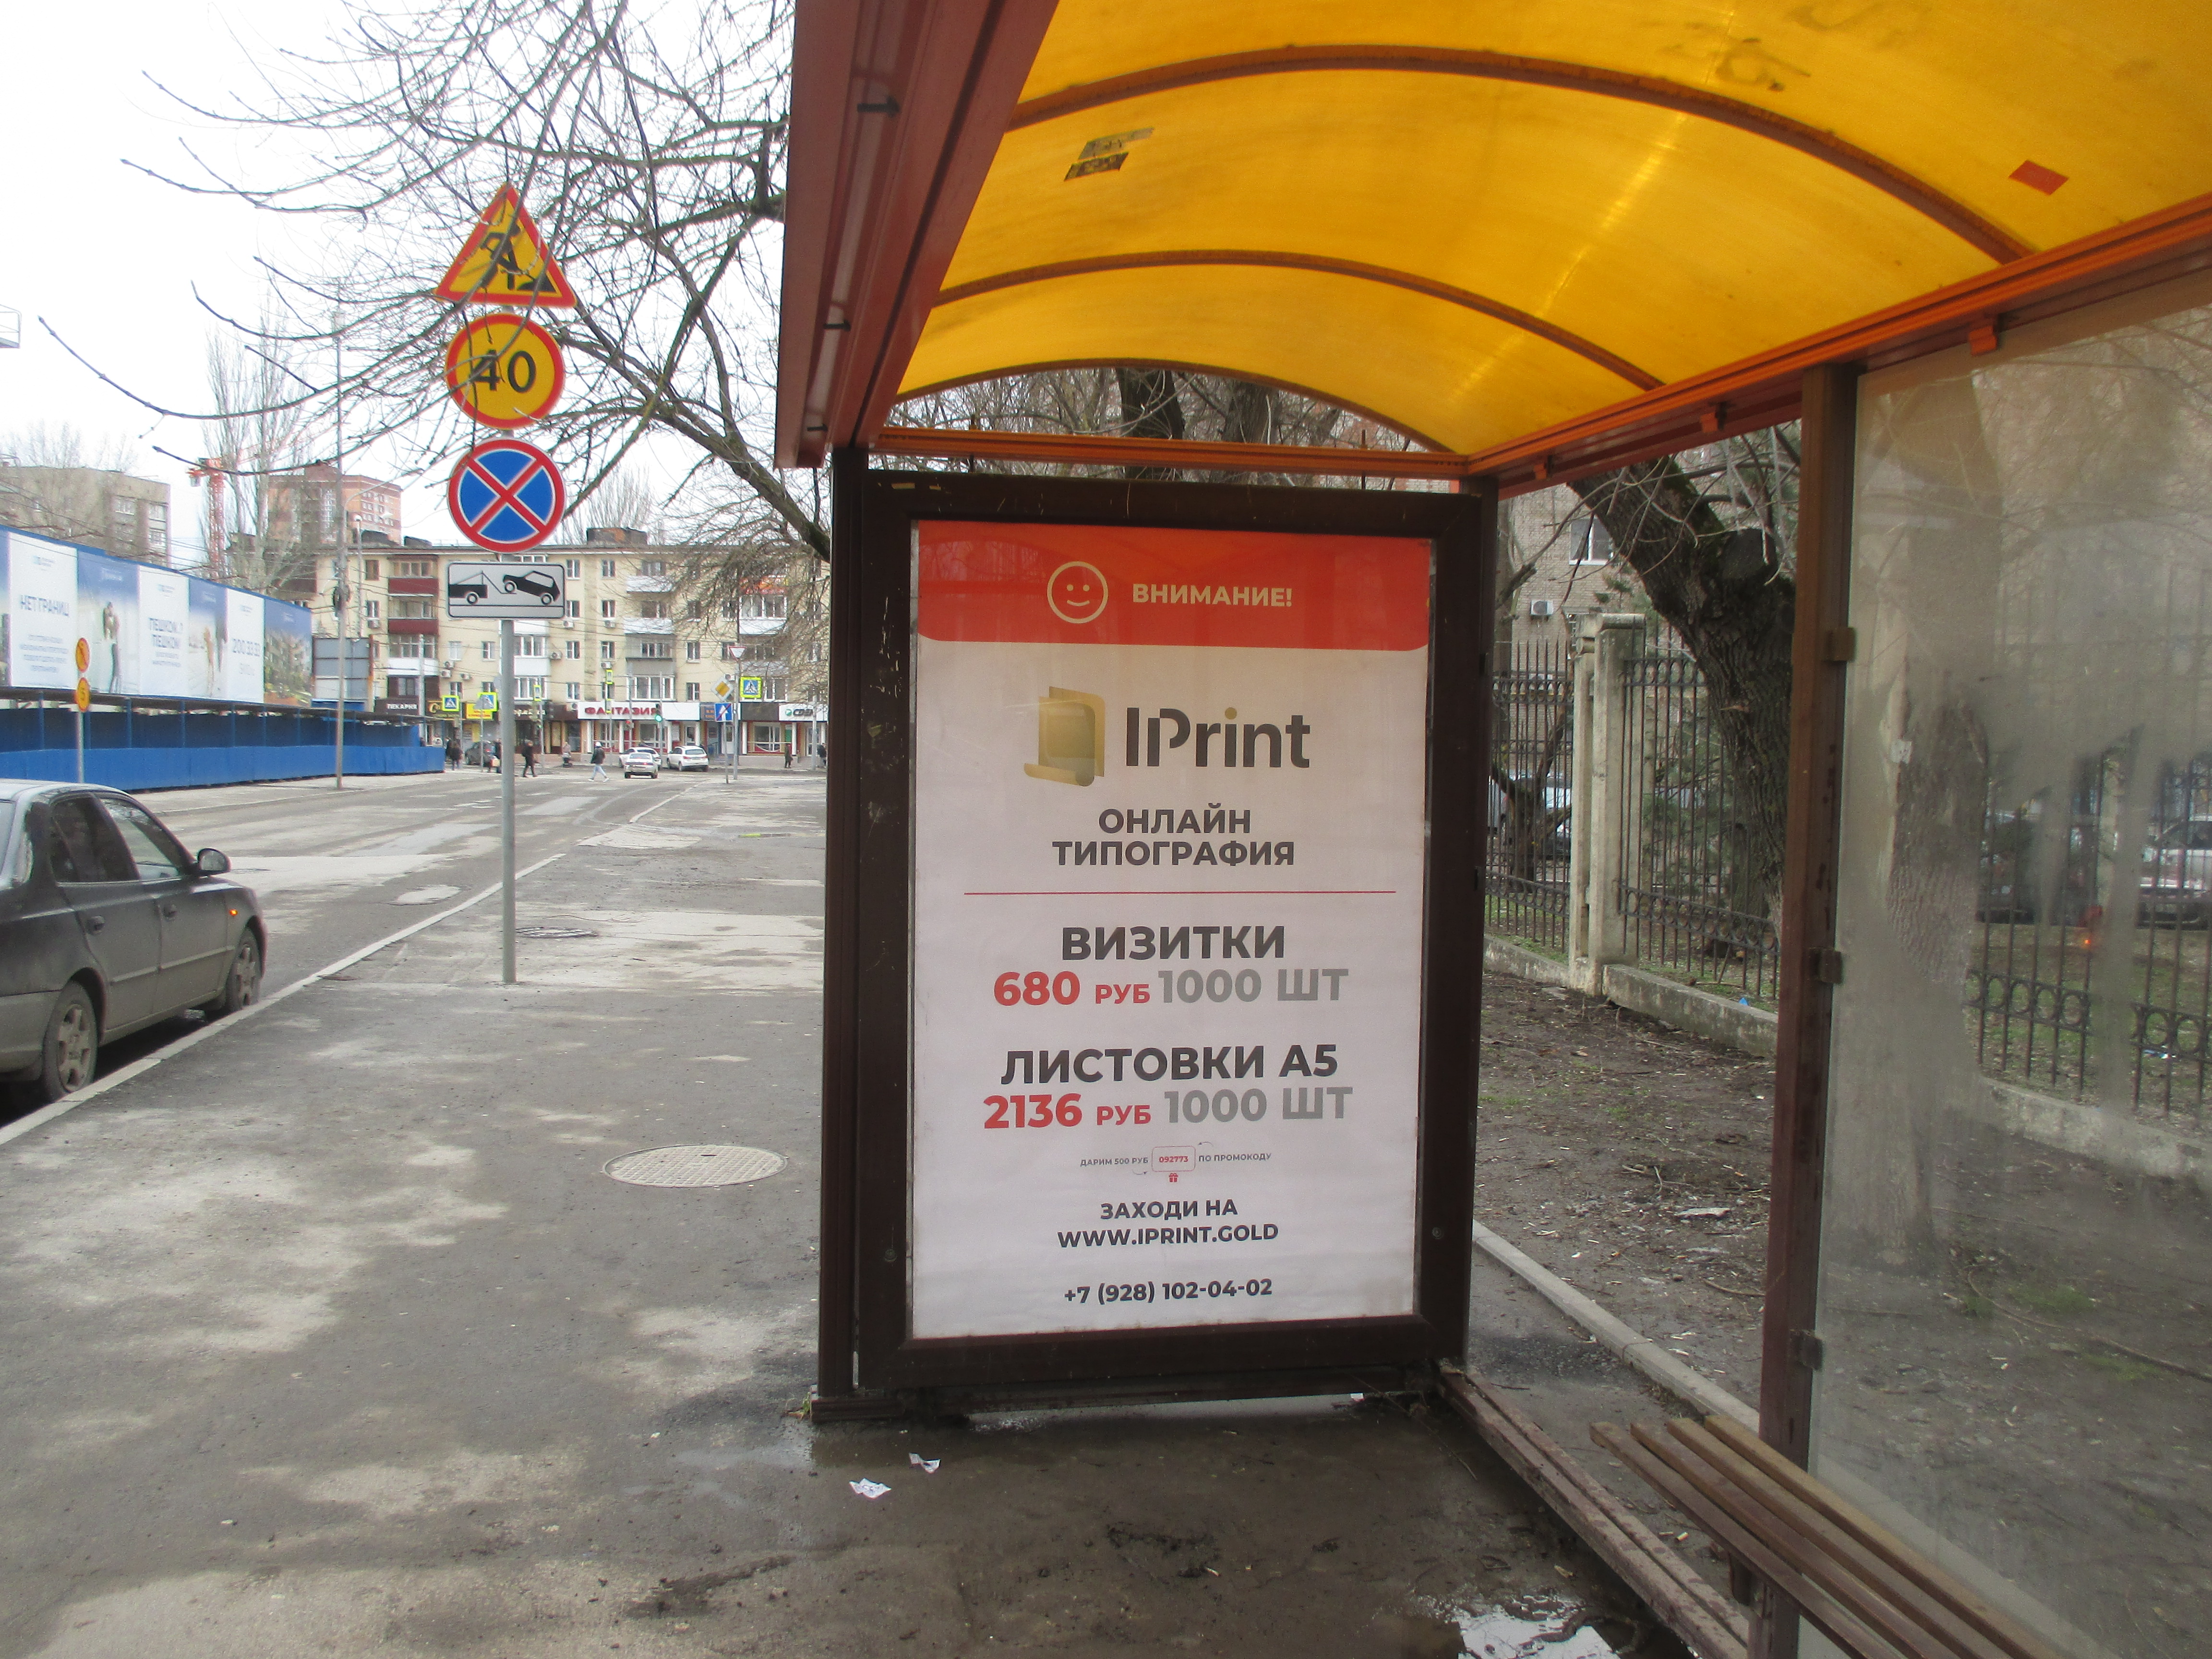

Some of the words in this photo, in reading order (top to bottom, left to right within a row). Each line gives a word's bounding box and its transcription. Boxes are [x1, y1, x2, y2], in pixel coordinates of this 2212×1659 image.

[469, 349, 536, 393] 40
[1134, 584, 1292, 607] ВНИМАНИЕ!
[1127, 707, 1310, 769] IPrint
[1099, 803, 1250, 834] ОНЛАЙН
[1053, 841, 1294, 866] ТИПОГРАФИЯ
[1063, 926, 1285, 961] ВИЗИТКИ
[995, 972, 1080, 1006] 680
[1096, 985, 1150, 1004] РУБ
[1159, 969, 1262, 1003] 1000
[1278, 969, 1349, 1001] ШТ
[1002, 1046, 1264, 1085] ЛИСТОВКИ
[1280, 1045, 1337, 1077] А5
[984, 1094, 1082, 1129] 2136
[1097, 1106, 1151, 1126] РУБ
[1165, 1089, 1267, 1123] 1000
[1283, 1087, 1353, 1120] ШТ
[1081, 1159, 1112, 1167] ДАРИМ
[1214, 1153, 1272, 1162] ПРОМОКОДУ
[1101, 1201, 1198, 1221] ЗАХОДИ
[1206, 1199, 1238, 1216] НА
[1058, 1224, 1278, 1248] WWW.IPRINT.GOLD
[1065, 1287, 1091, 1304] +7
[1099, 1282, 1155, 1305] (928)
[1163, 1279, 1272, 1300] 102-04-02
